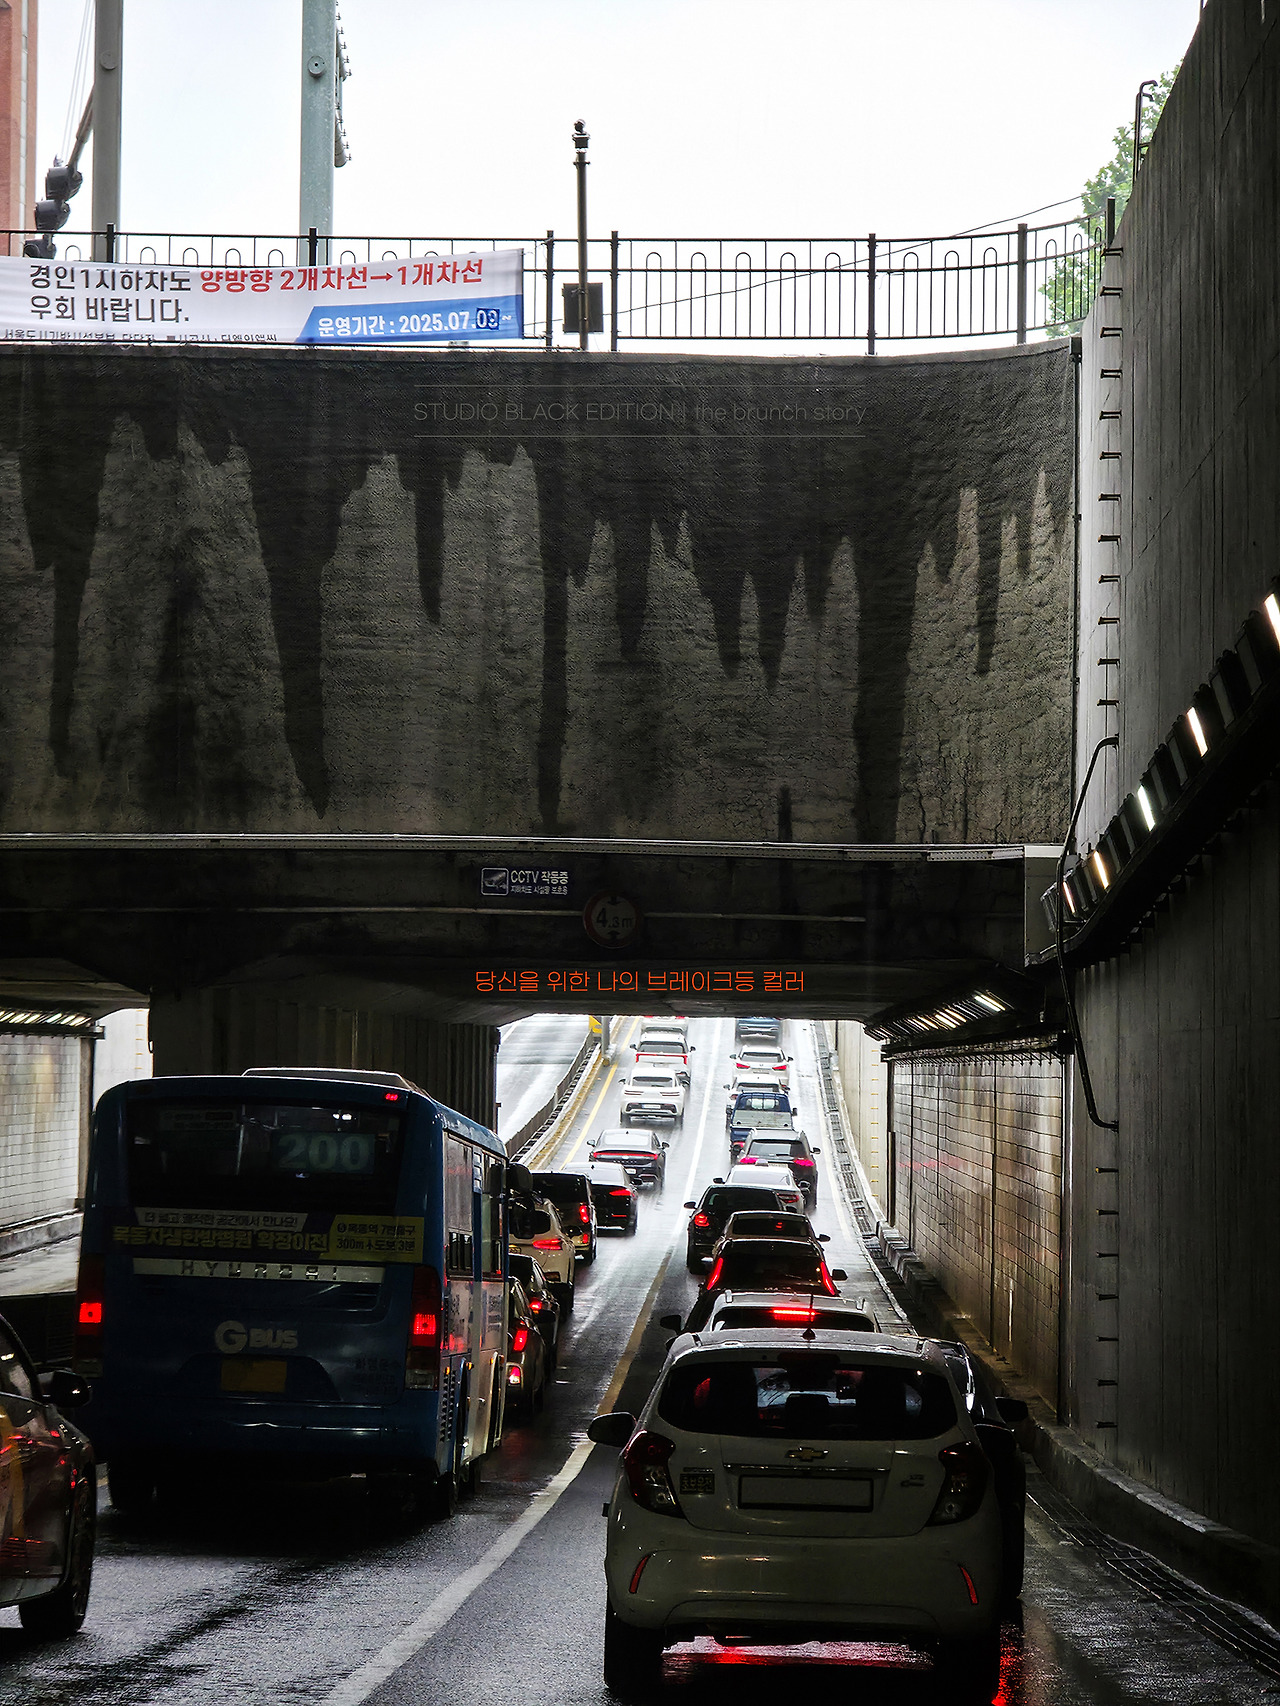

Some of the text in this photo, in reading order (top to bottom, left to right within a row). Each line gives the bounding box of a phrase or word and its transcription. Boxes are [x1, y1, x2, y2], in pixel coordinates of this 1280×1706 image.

[30, 264, 192, 292] 경인1지하차도
[200, 269, 274, 293] 양방향
[30, 294, 189, 323] 우회 바랍니다.
[318, 316, 385, 337] 운영기간
[510, 870, 569, 885] CCTV 작동중
[277, 1133, 371, 1171] 200
[336, 1239, 364, 1249] 300m
[181, 1260, 338, 1280] HYUNDAI
